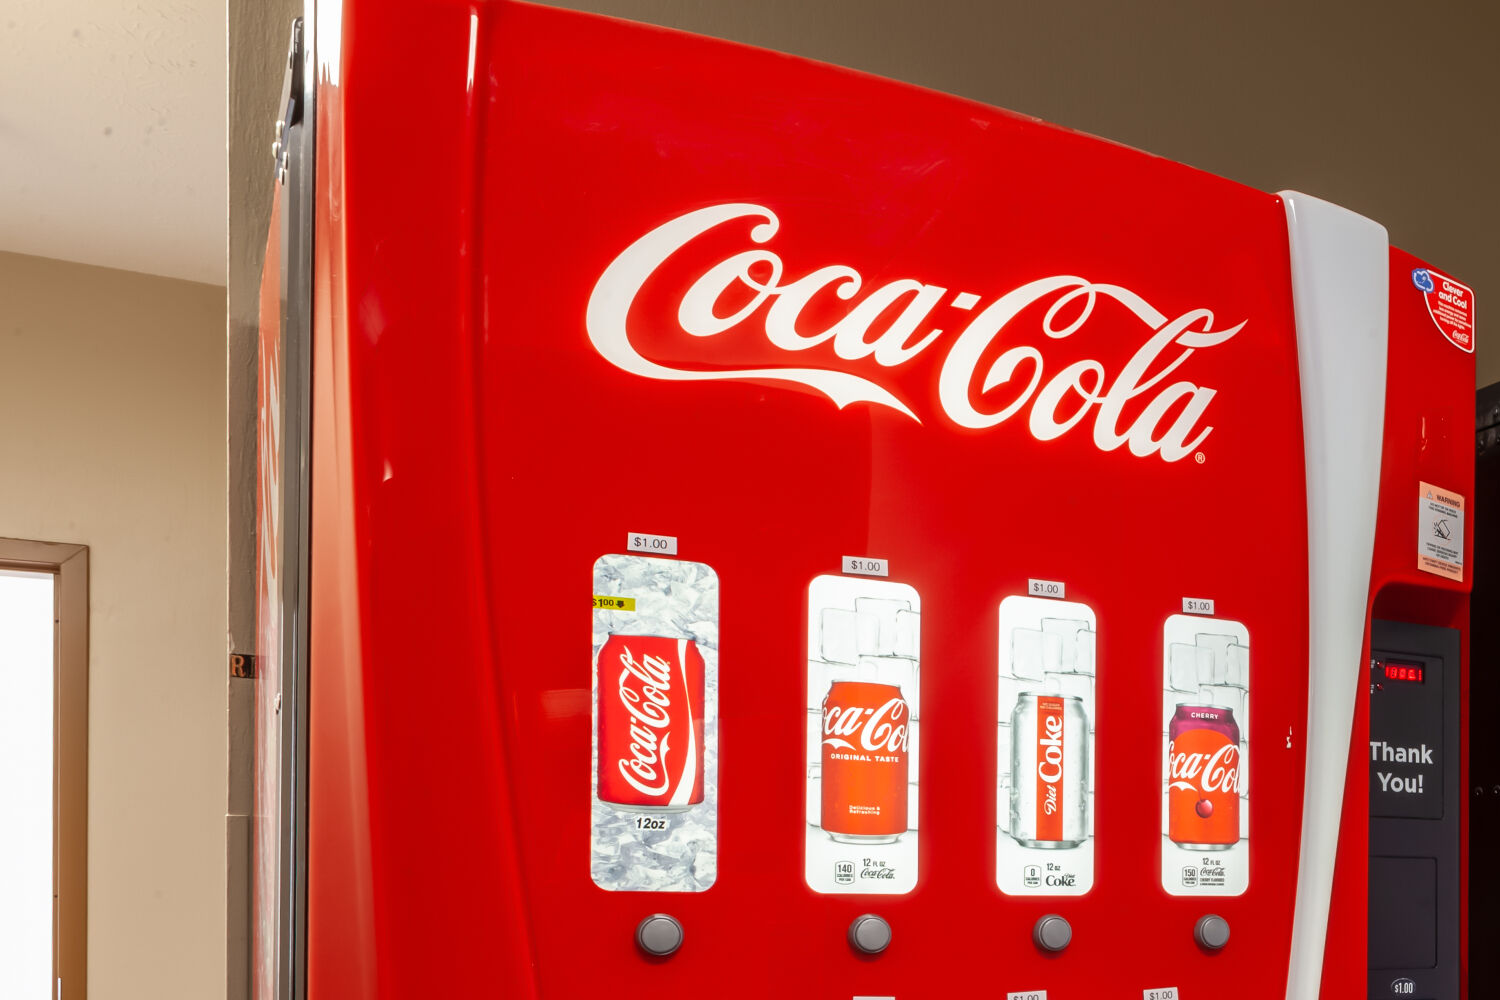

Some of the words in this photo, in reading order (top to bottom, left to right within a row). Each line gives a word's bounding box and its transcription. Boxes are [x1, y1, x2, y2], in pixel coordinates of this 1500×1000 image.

[1442, 281, 1464, 298] Clever
[1438, 291, 1452, 304] and
[1452, 296, 1468, 310] Cool
[585, 202, 1249, 462] Coca-Cola
[633, 536, 668, 550] $1.00
[850, 559, 881, 574] $1.00
[1033, 582, 1059, 595] $1.00
[1187, 600, 1211, 612] $1.00
[618, 645, 671, 797] Coca-Cola
[1191, 712, 1219, 720] CHERRY
[1038, 715, 1063, 783] Coke
[1370, 741, 1434, 765] Thank
[830, 753, 871, 762] ORIGINAL
[875, 755, 900, 763] TASTE
[1377, 772, 1424, 794] You!
[1044, 784, 1057, 815] Diet
[636, 817, 666, 830] 12oz
[863, 858, 871, 867] 12
[1046, 862, 1054, 871] 12
[1202, 857, 1209, 866] 12
[838, 864, 852, 873] 140
[1184, 868, 1196, 877] 150
[1045, 874, 1076, 887] Coke
[1148, 989, 1173, 1000] $1.00
[1394, 982, 1414, 994] $1.00
